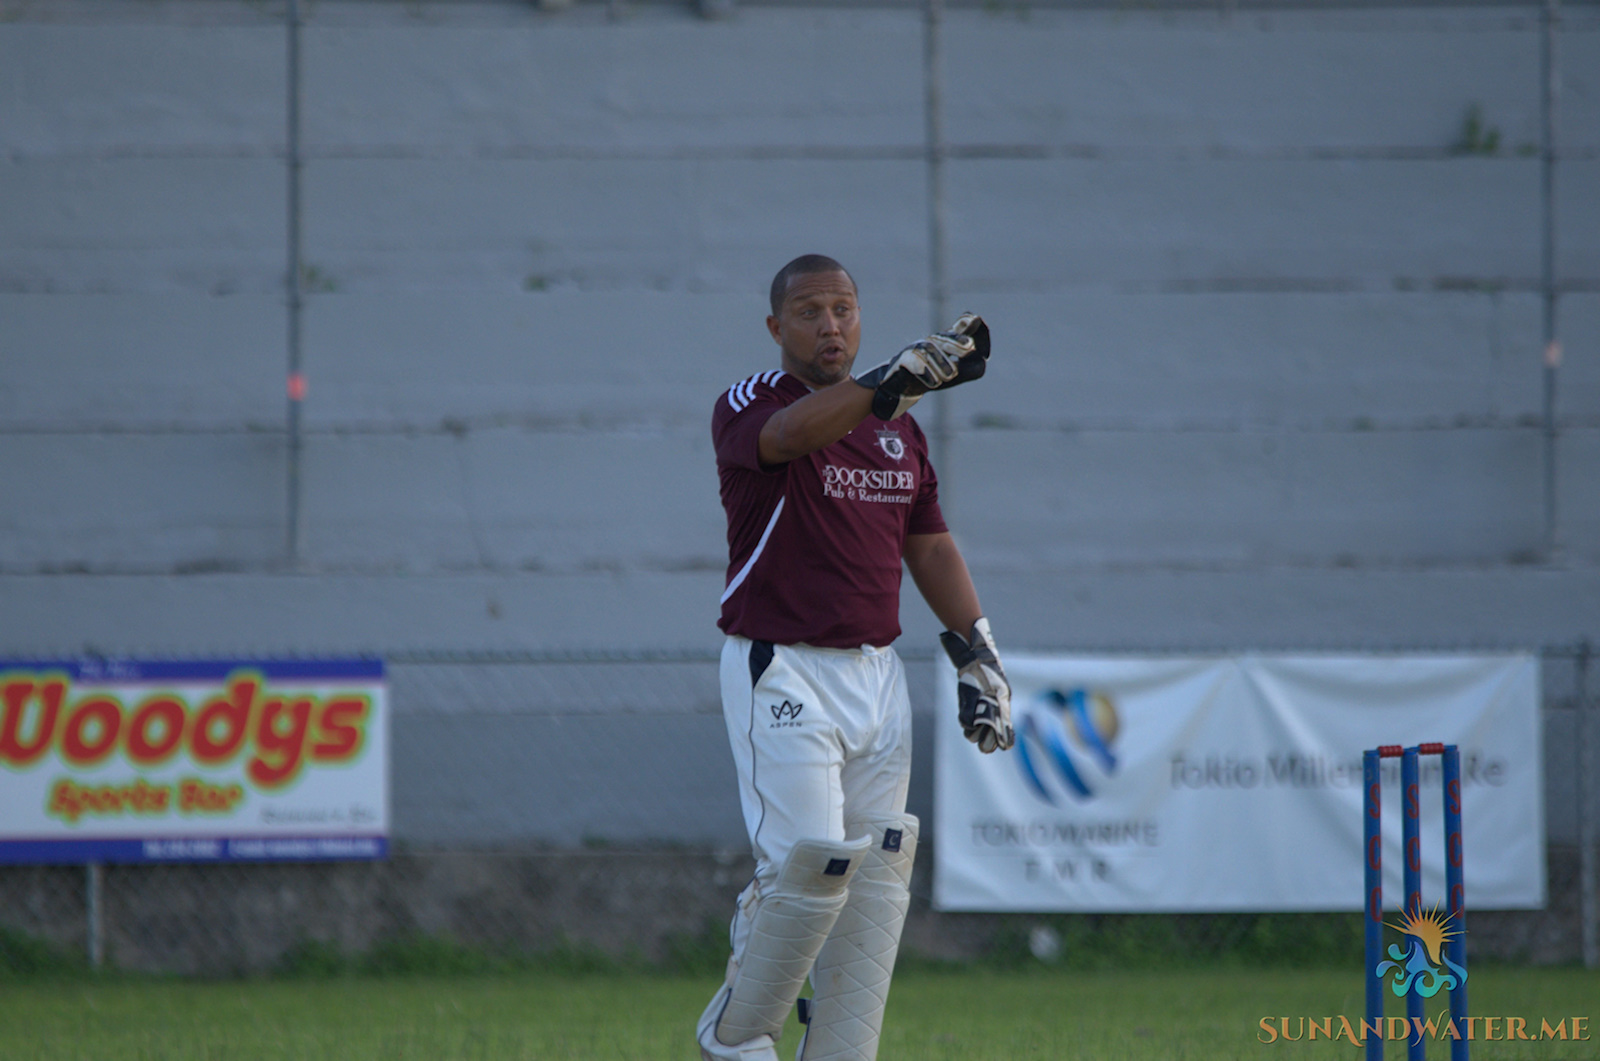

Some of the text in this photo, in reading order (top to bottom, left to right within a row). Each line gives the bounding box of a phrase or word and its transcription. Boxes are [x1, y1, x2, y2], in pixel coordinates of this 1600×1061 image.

[825, 465, 914, 490] DOCKSIDER
[823, 482, 913, 504] Pub & Restaurant
[770, 721, 803, 729] ASPEN
[1170, 750, 1262, 788] Tokio
